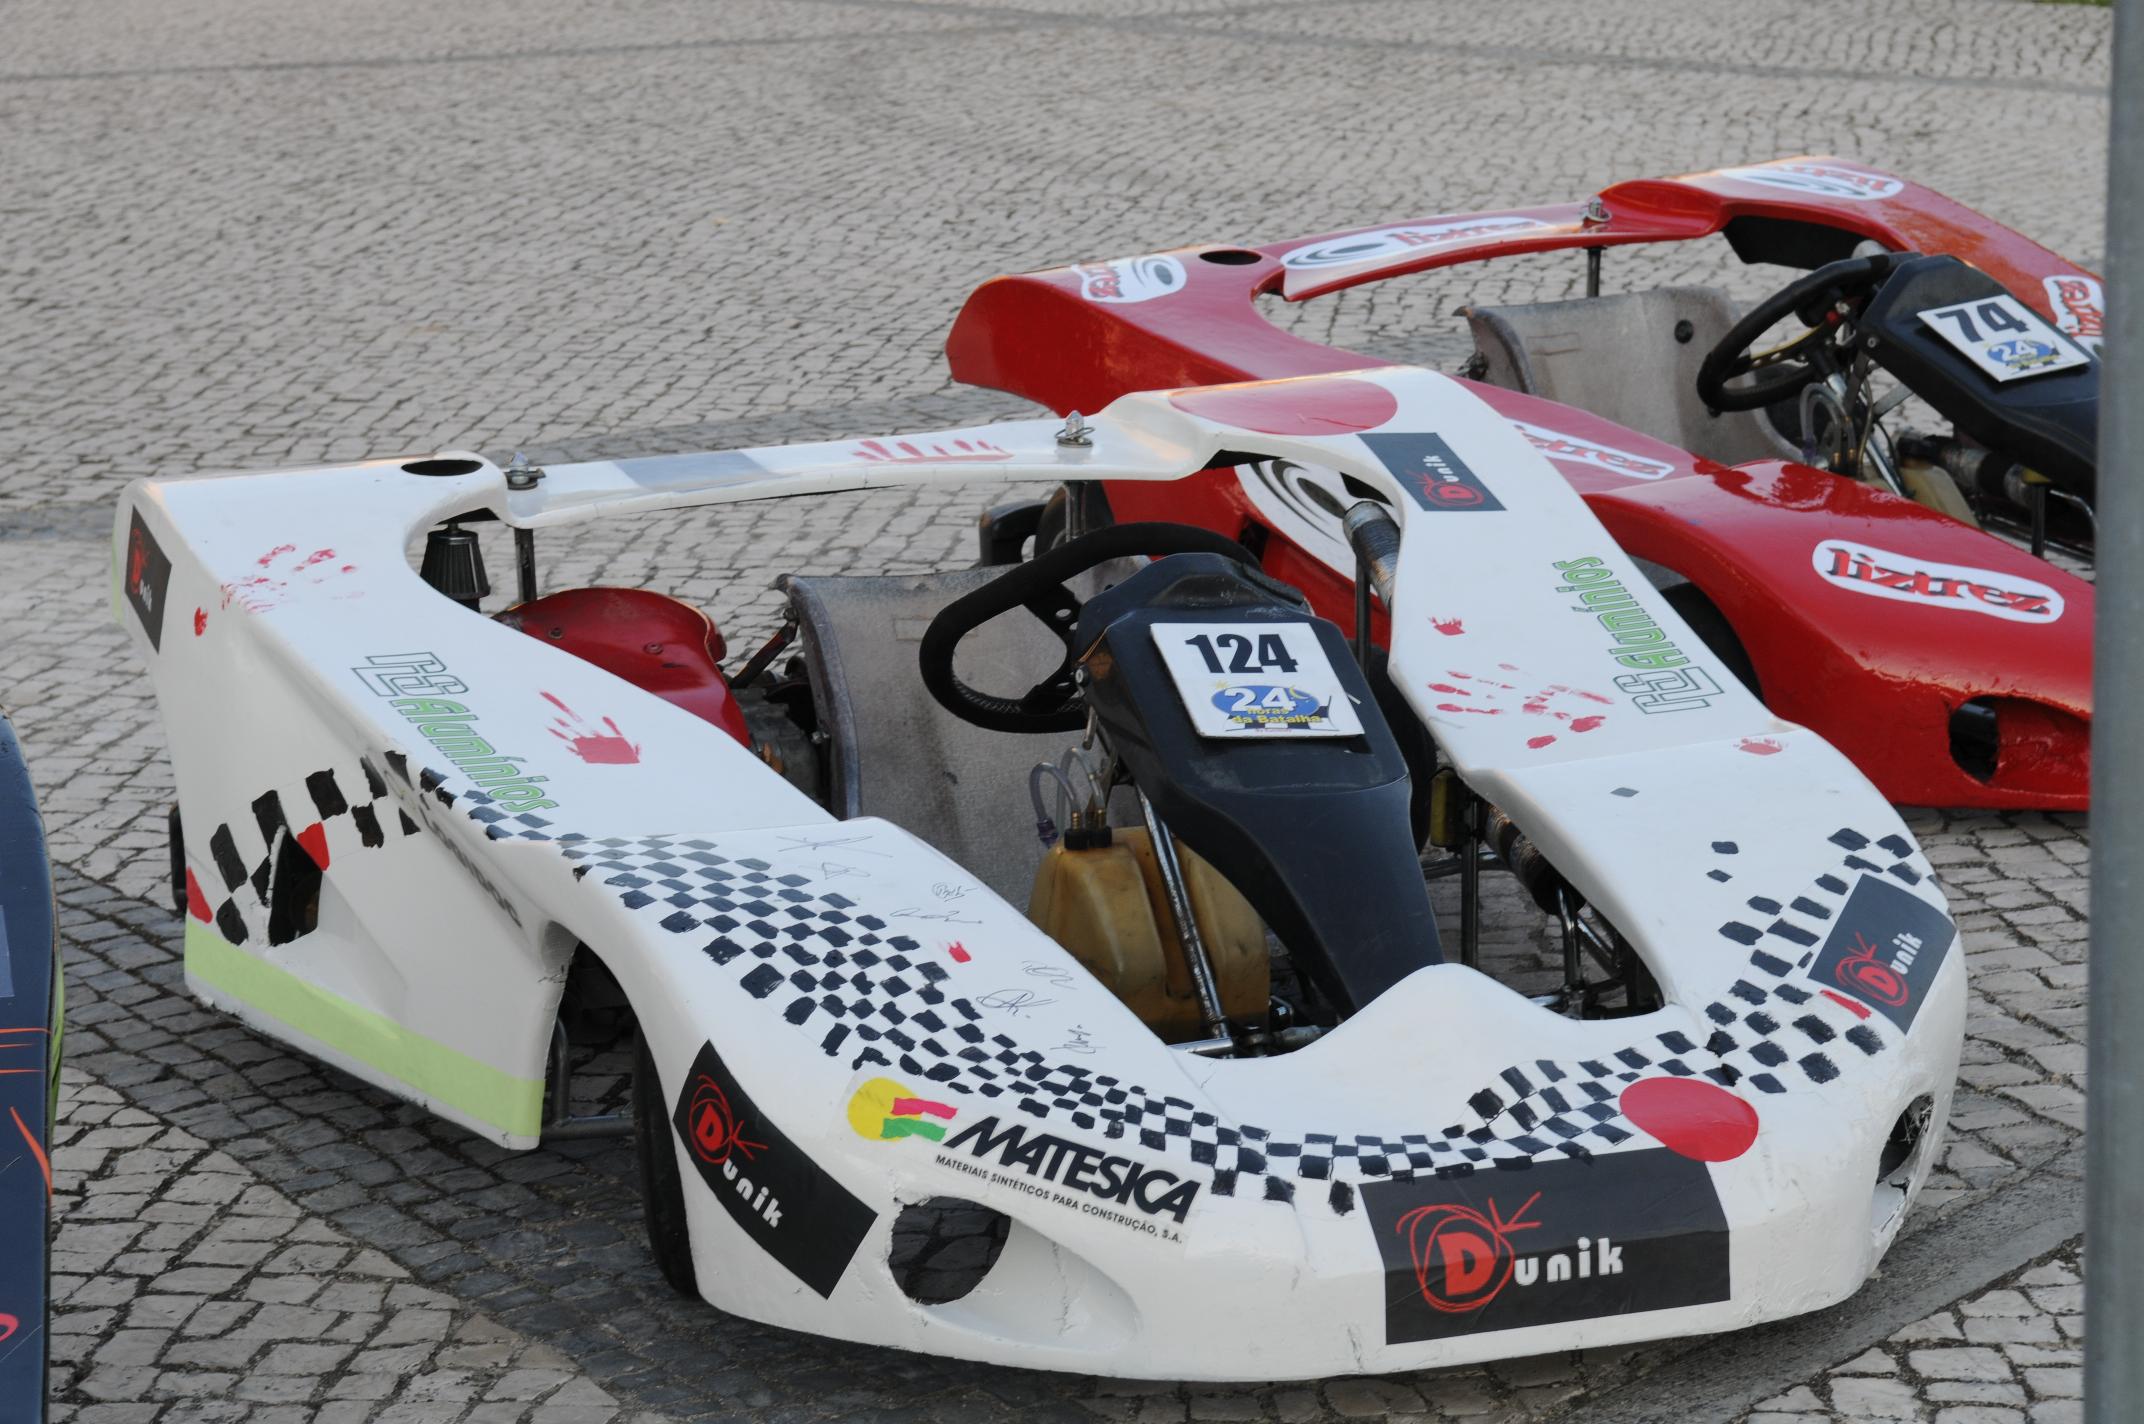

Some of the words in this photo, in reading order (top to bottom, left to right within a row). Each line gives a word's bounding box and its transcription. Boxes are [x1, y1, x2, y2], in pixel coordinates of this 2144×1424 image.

[1934, 302, 2031, 343] 74
[1826, 546, 2052, 616] liztrez
[1184, 633, 1299, 674] 124
[1224, 686, 1297, 711] 24
[1231, 715, 1253, 724] da
[1258, 714, 1322, 724] Batalha
[1247, 706, 1290, 716] horas
[695, 1101, 784, 1229] Dunik
[942, 1115, 1203, 1225] MATESICA
[935, 1153, 988, 1180] MATERIAIS
[989, 1171, 1051, 1202] SINTÉTICOS
[1051, 1193, 1080, 1210] PARA
[1161, 1226, 1184, 1244] S.A.
[1437, 1231, 1625, 1297] Dunik
